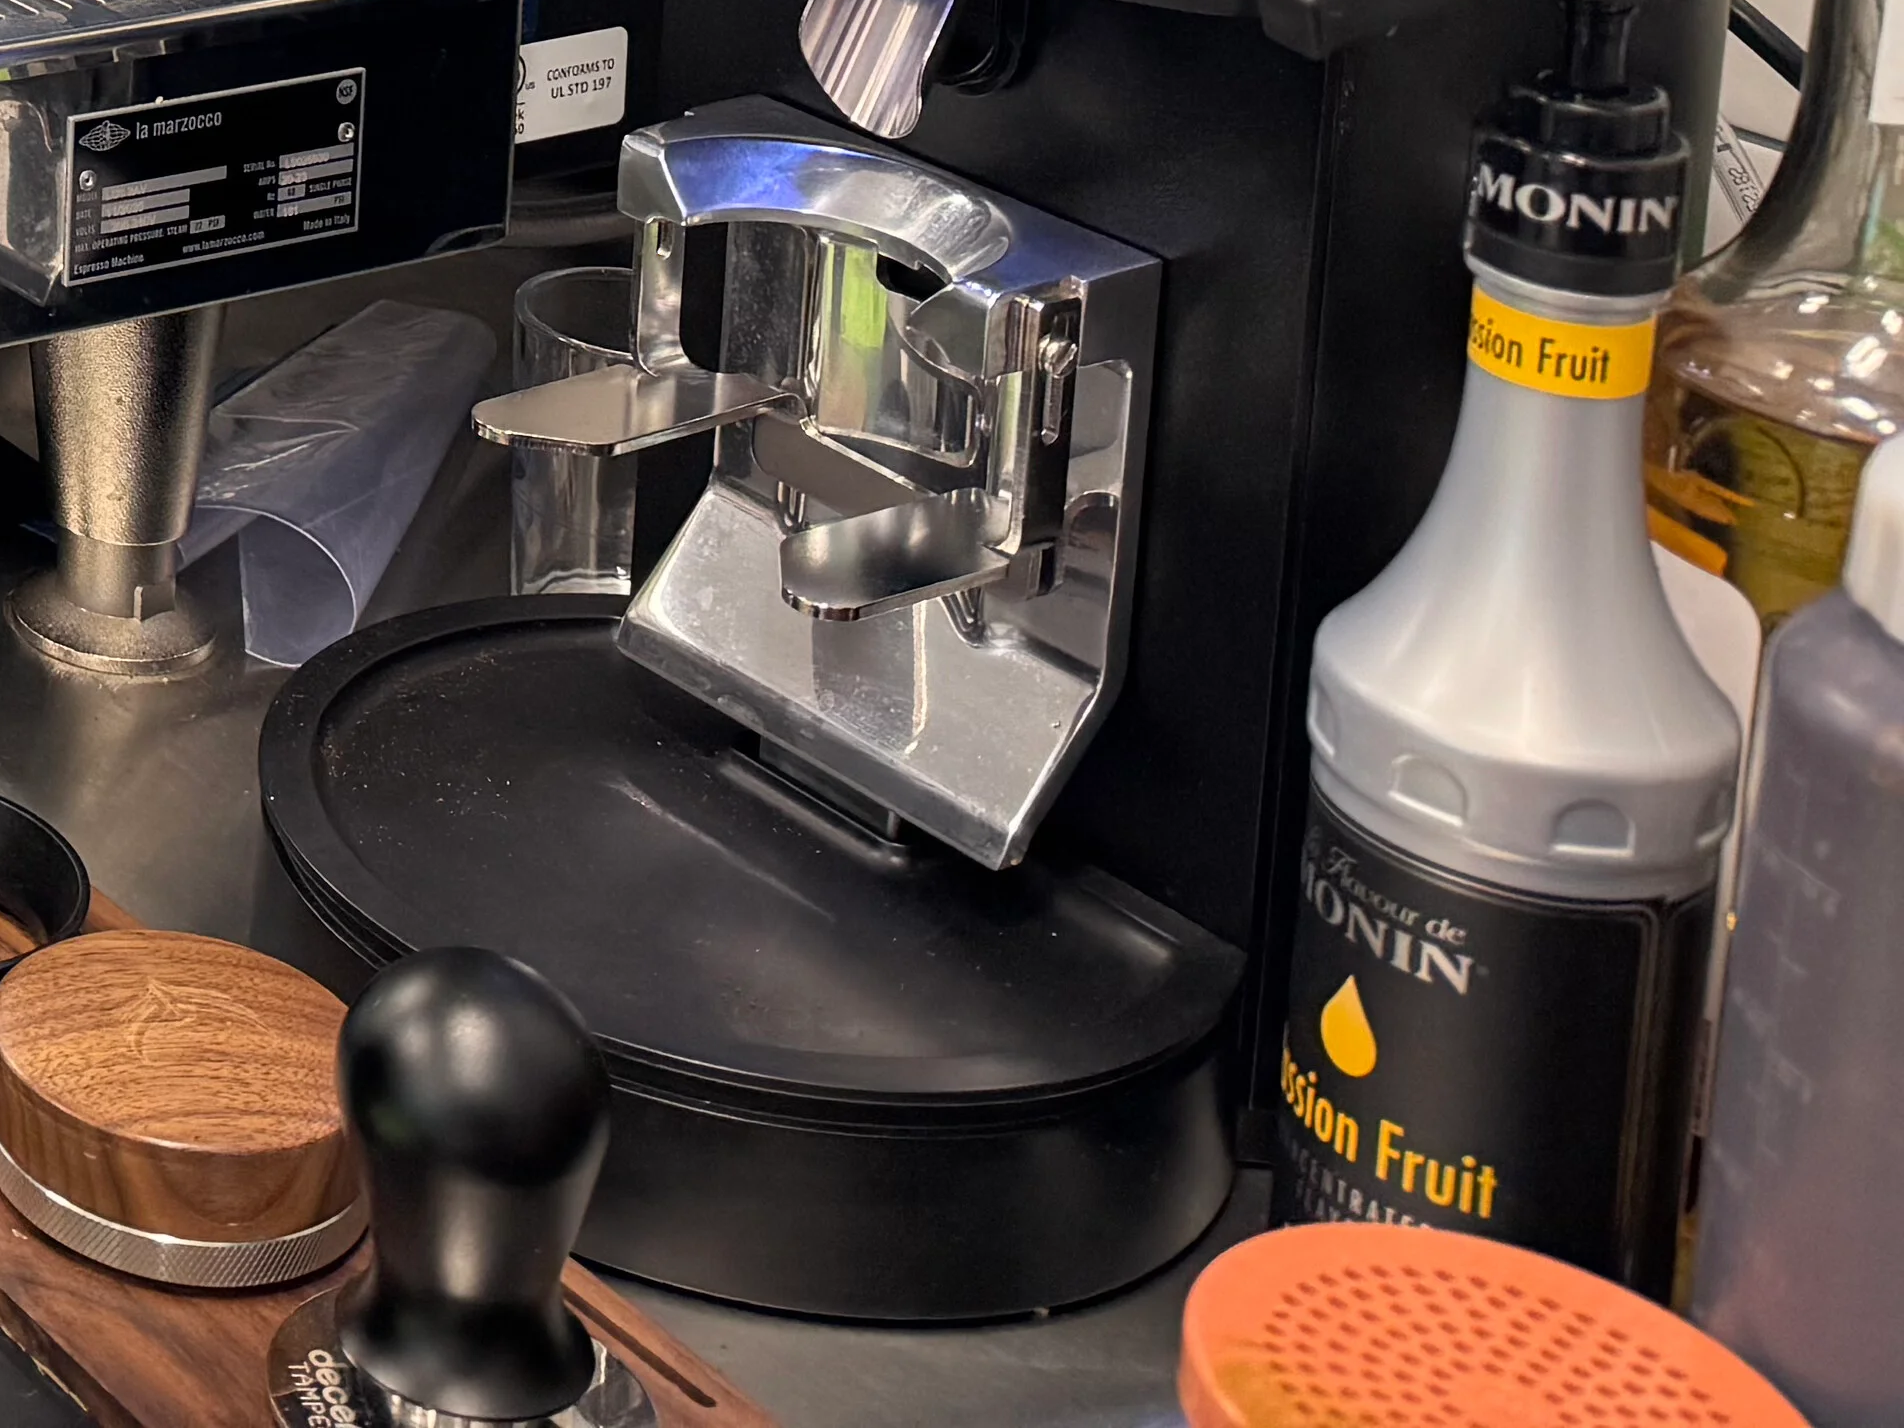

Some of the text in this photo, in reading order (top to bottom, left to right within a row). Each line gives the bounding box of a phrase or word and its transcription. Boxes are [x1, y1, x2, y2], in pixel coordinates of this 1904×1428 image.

[547, 58, 615, 81] CONFORMS TO
[551, 76, 612, 99] UL STD 197
[136, 111, 223, 140] la marzocco
[1477, 162, 1678, 233] MONIN
[303, 219, 324, 232] Made
[334, 213, 351, 225] Italy
[182, 230, 266, 254] www.lamarzocco.com
[73, 254, 145, 276] Espresso Machine
[1537, 337, 1610, 384] Fruit
[1425, 919, 1467, 945] de
[1375, 1119, 1498, 1219] Fruit
